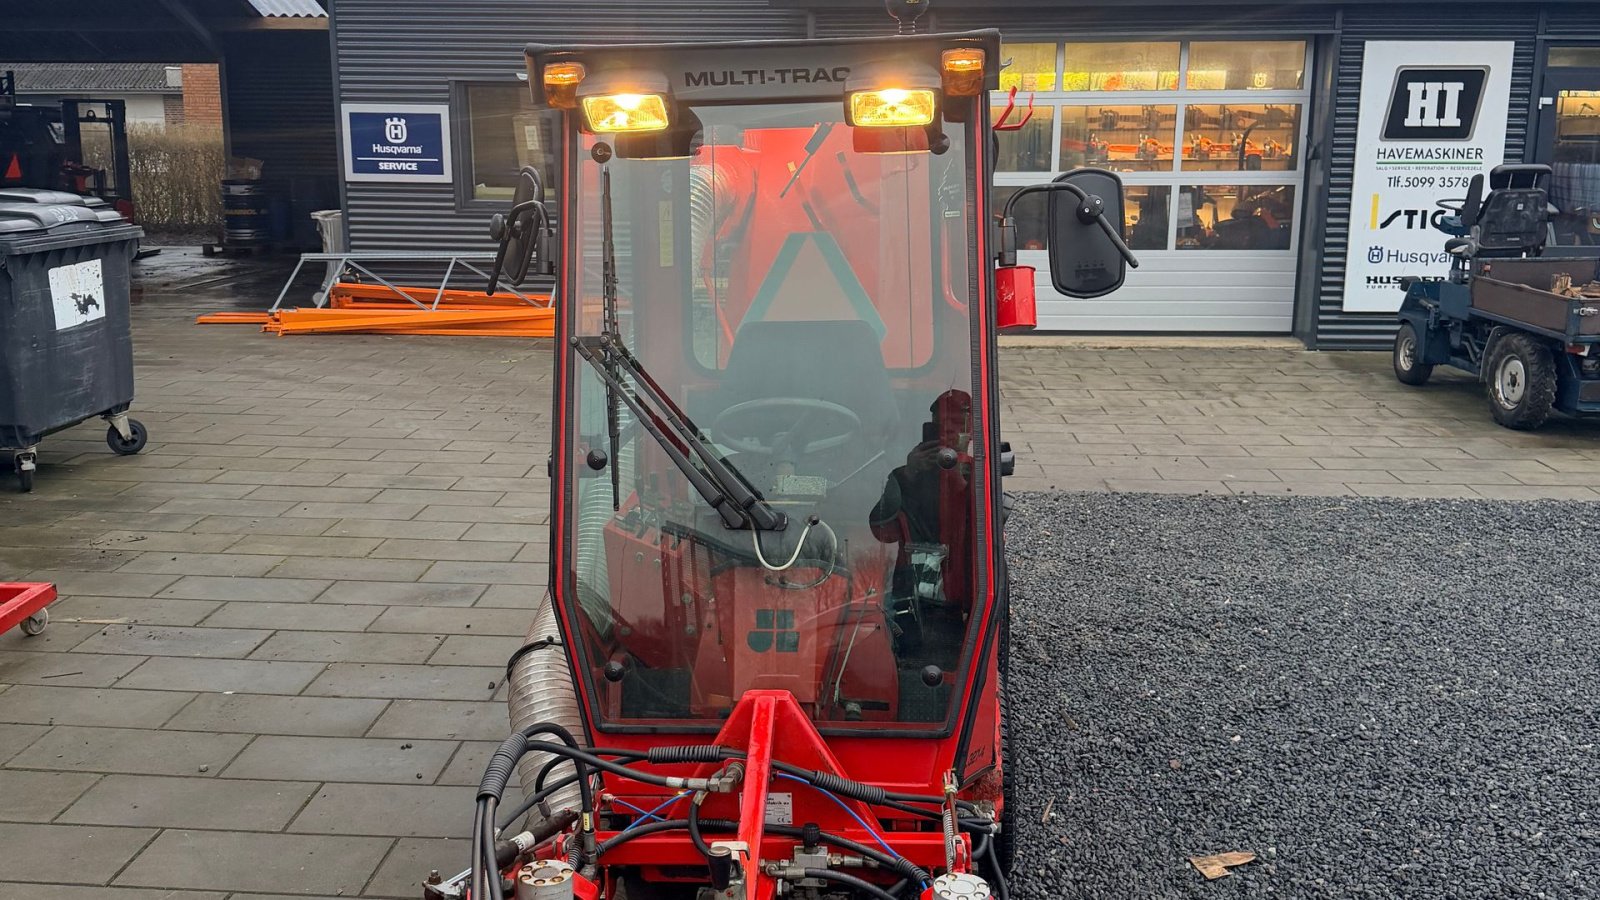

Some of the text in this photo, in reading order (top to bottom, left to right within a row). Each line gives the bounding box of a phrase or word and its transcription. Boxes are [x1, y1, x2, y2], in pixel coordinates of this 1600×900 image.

[684, 67, 851, 87] MULTI-TRAC
[1404, 82, 1464, 127] HI
[372, 144, 422, 155] Husqvarna
[1377, 148, 1483, 159] HAVEMASKINER
[378, 162, 418, 171] SERVICE
[1439, 177, 1469, 188] 3578
[1380, 209, 1447, 229] STIG
[1387, 249, 1454, 266] Husqvar
